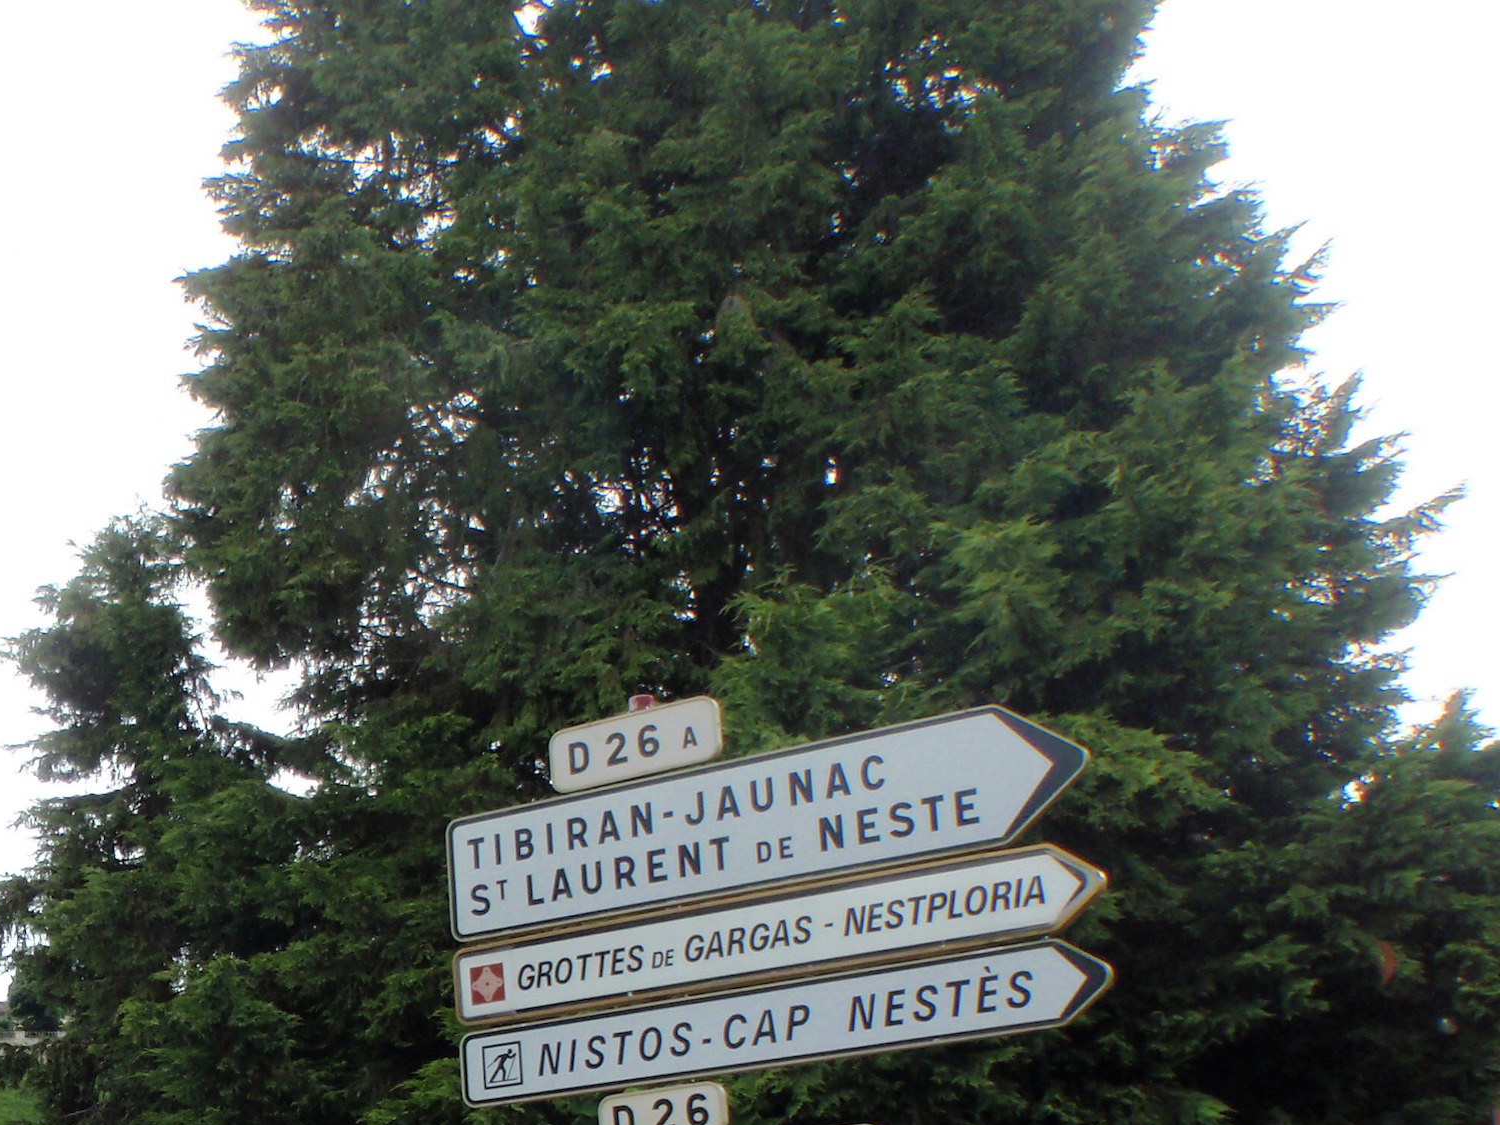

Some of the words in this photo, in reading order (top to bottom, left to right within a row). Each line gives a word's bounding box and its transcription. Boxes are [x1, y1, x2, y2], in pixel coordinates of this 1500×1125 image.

[467, 755, 886, 870] TIBIRAN-JAUNAC
[527, 835, 730, 906] LAURENT
[756, 836, 794, 864] DE
[818, 788, 980, 851] NESTE
[518, 945, 644, 991] GROTTES
[652, 949, 674, 969] DE
[684, 915, 812, 962] GARGAS
[843, 875, 1046, 937] NESTPLORIA
[538, 1004, 810, 1077] NISTOS-CAP
[848, 966, 1034, 1032] NESTÈS
